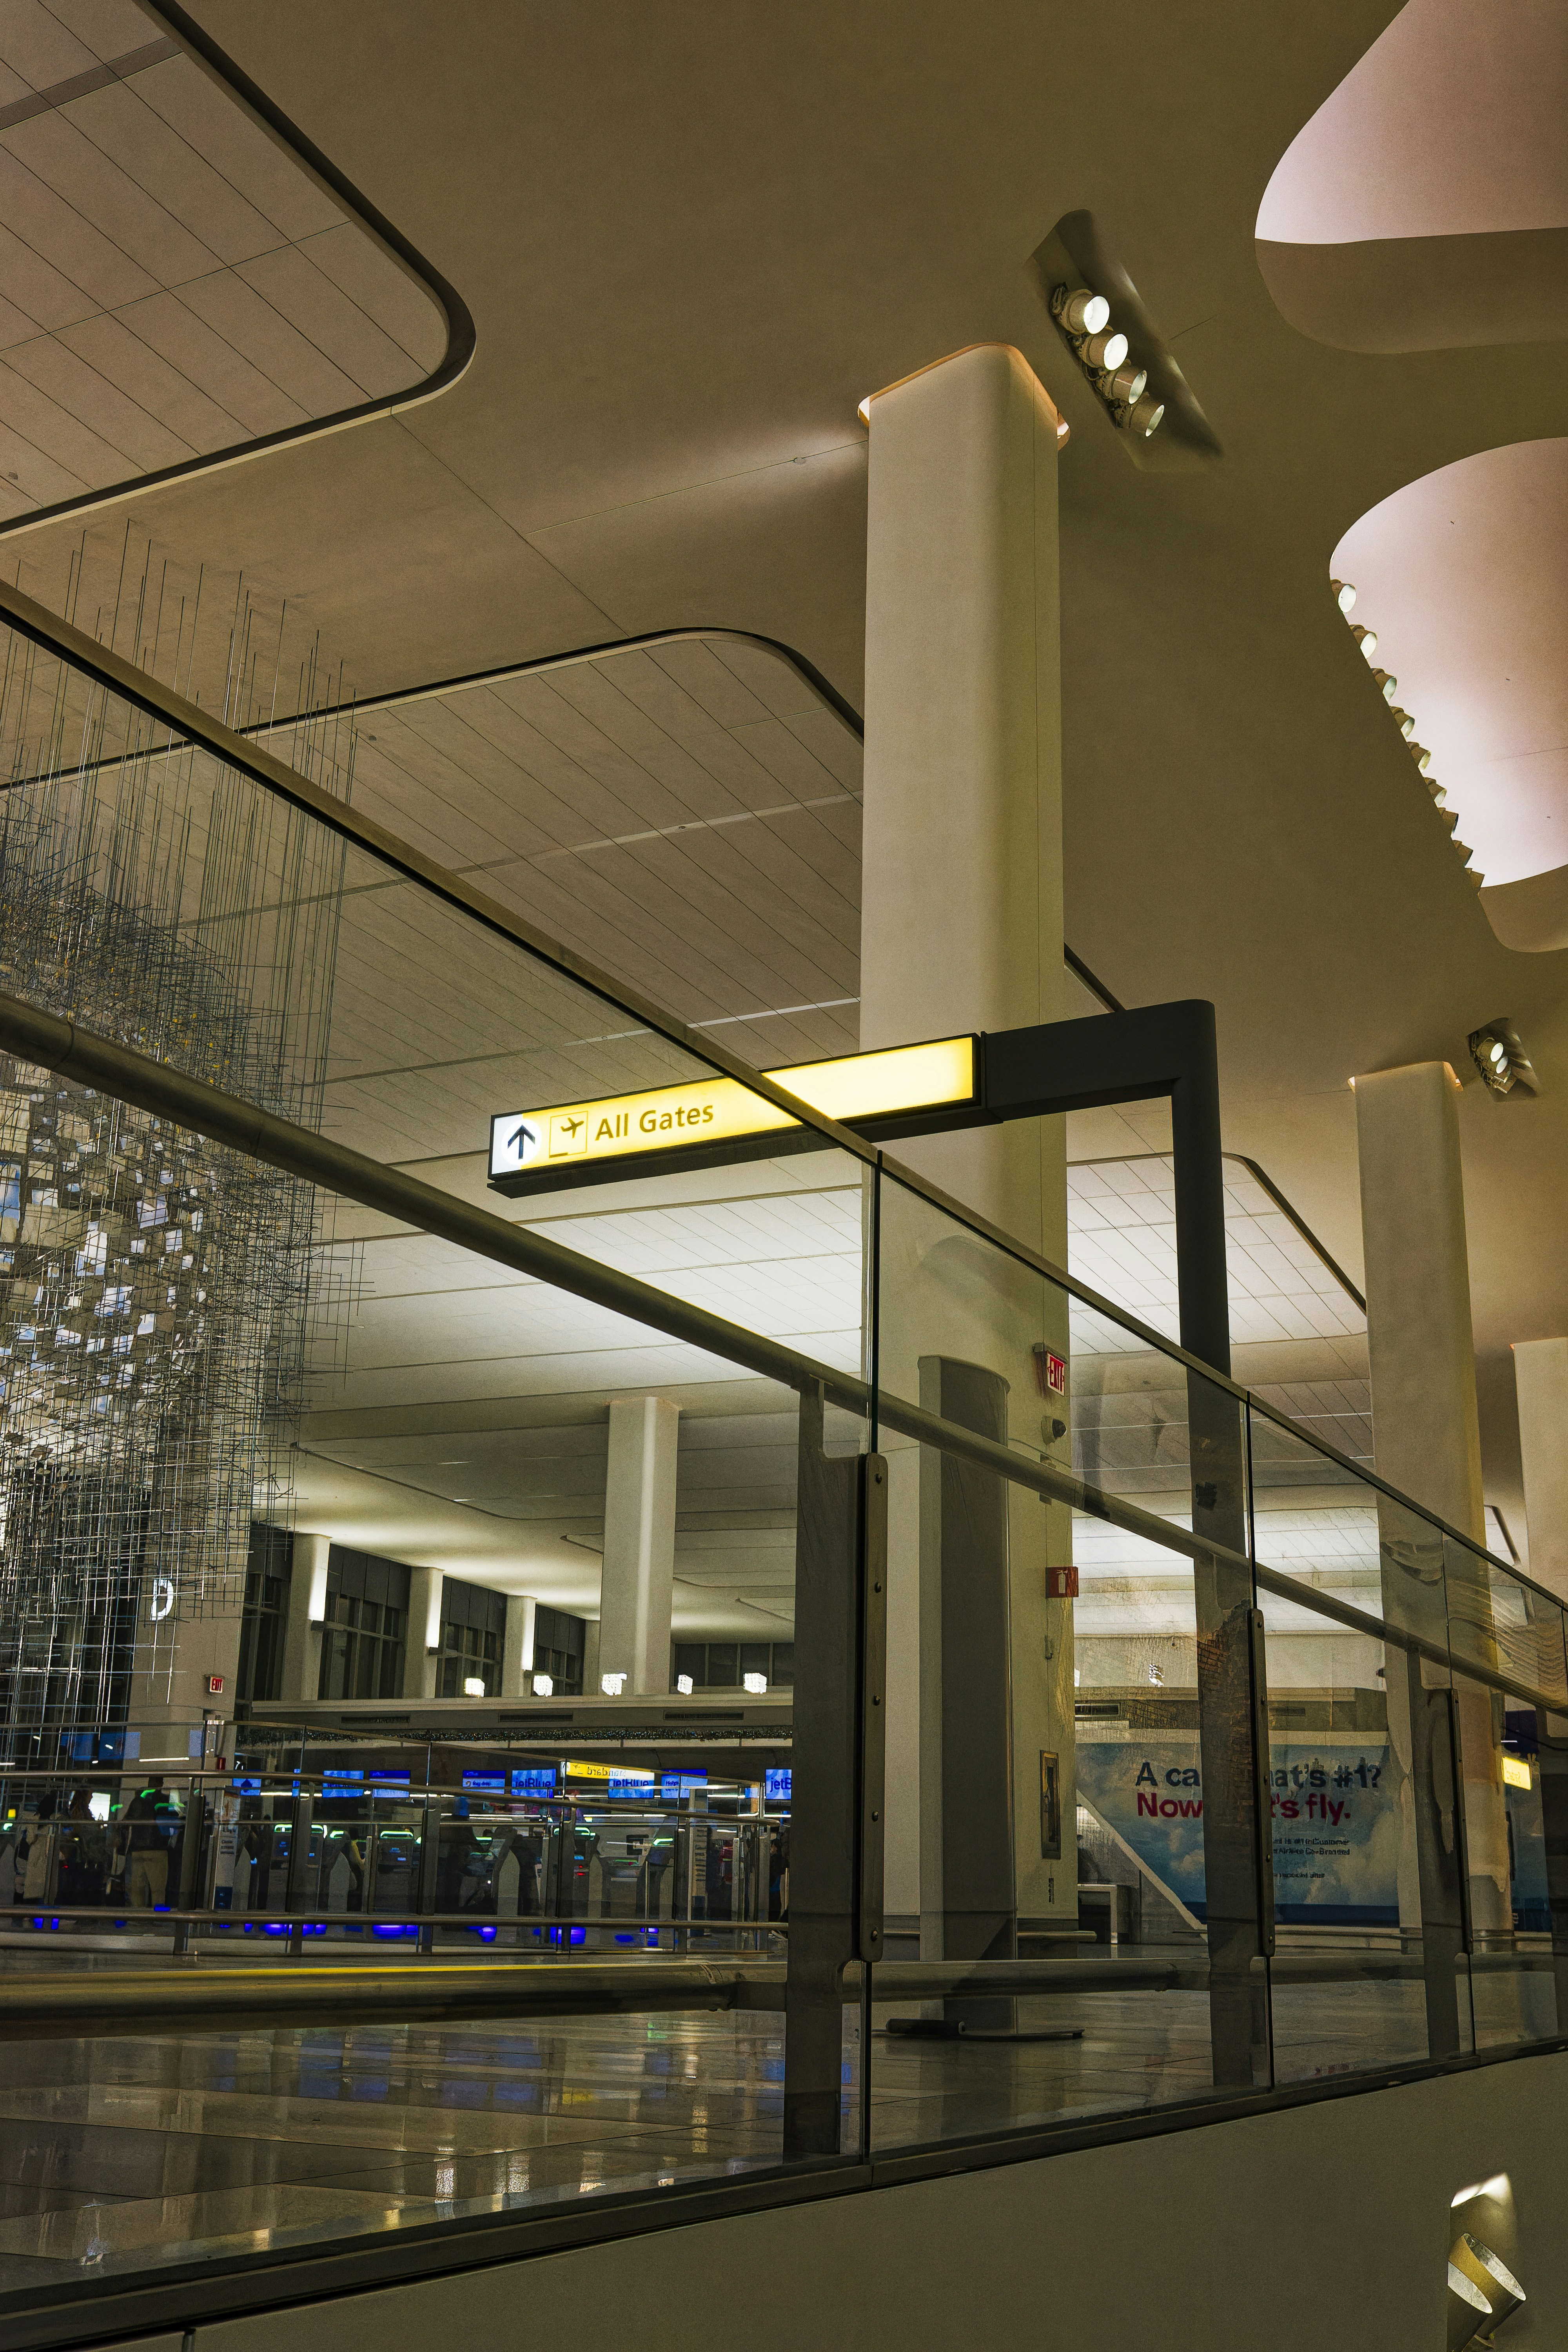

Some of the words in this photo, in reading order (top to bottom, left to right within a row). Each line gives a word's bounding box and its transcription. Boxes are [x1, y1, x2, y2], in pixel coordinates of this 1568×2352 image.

[595, 1112, 628, 1141] All
[639, 1105, 713, 1133] Gates
[1049, 1356, 1064, 1392] EXIT
[769, 1777, 791, 1793] jetB
[1135, 1762, 1158, 1786] A
[1165, 1768, 1201, 1787] ca
[1270, 1763, 1327, 1788] at's
[1137, 1792, 1203, 1818] Now
[1305, 1793, 1351, 1826] fly.
